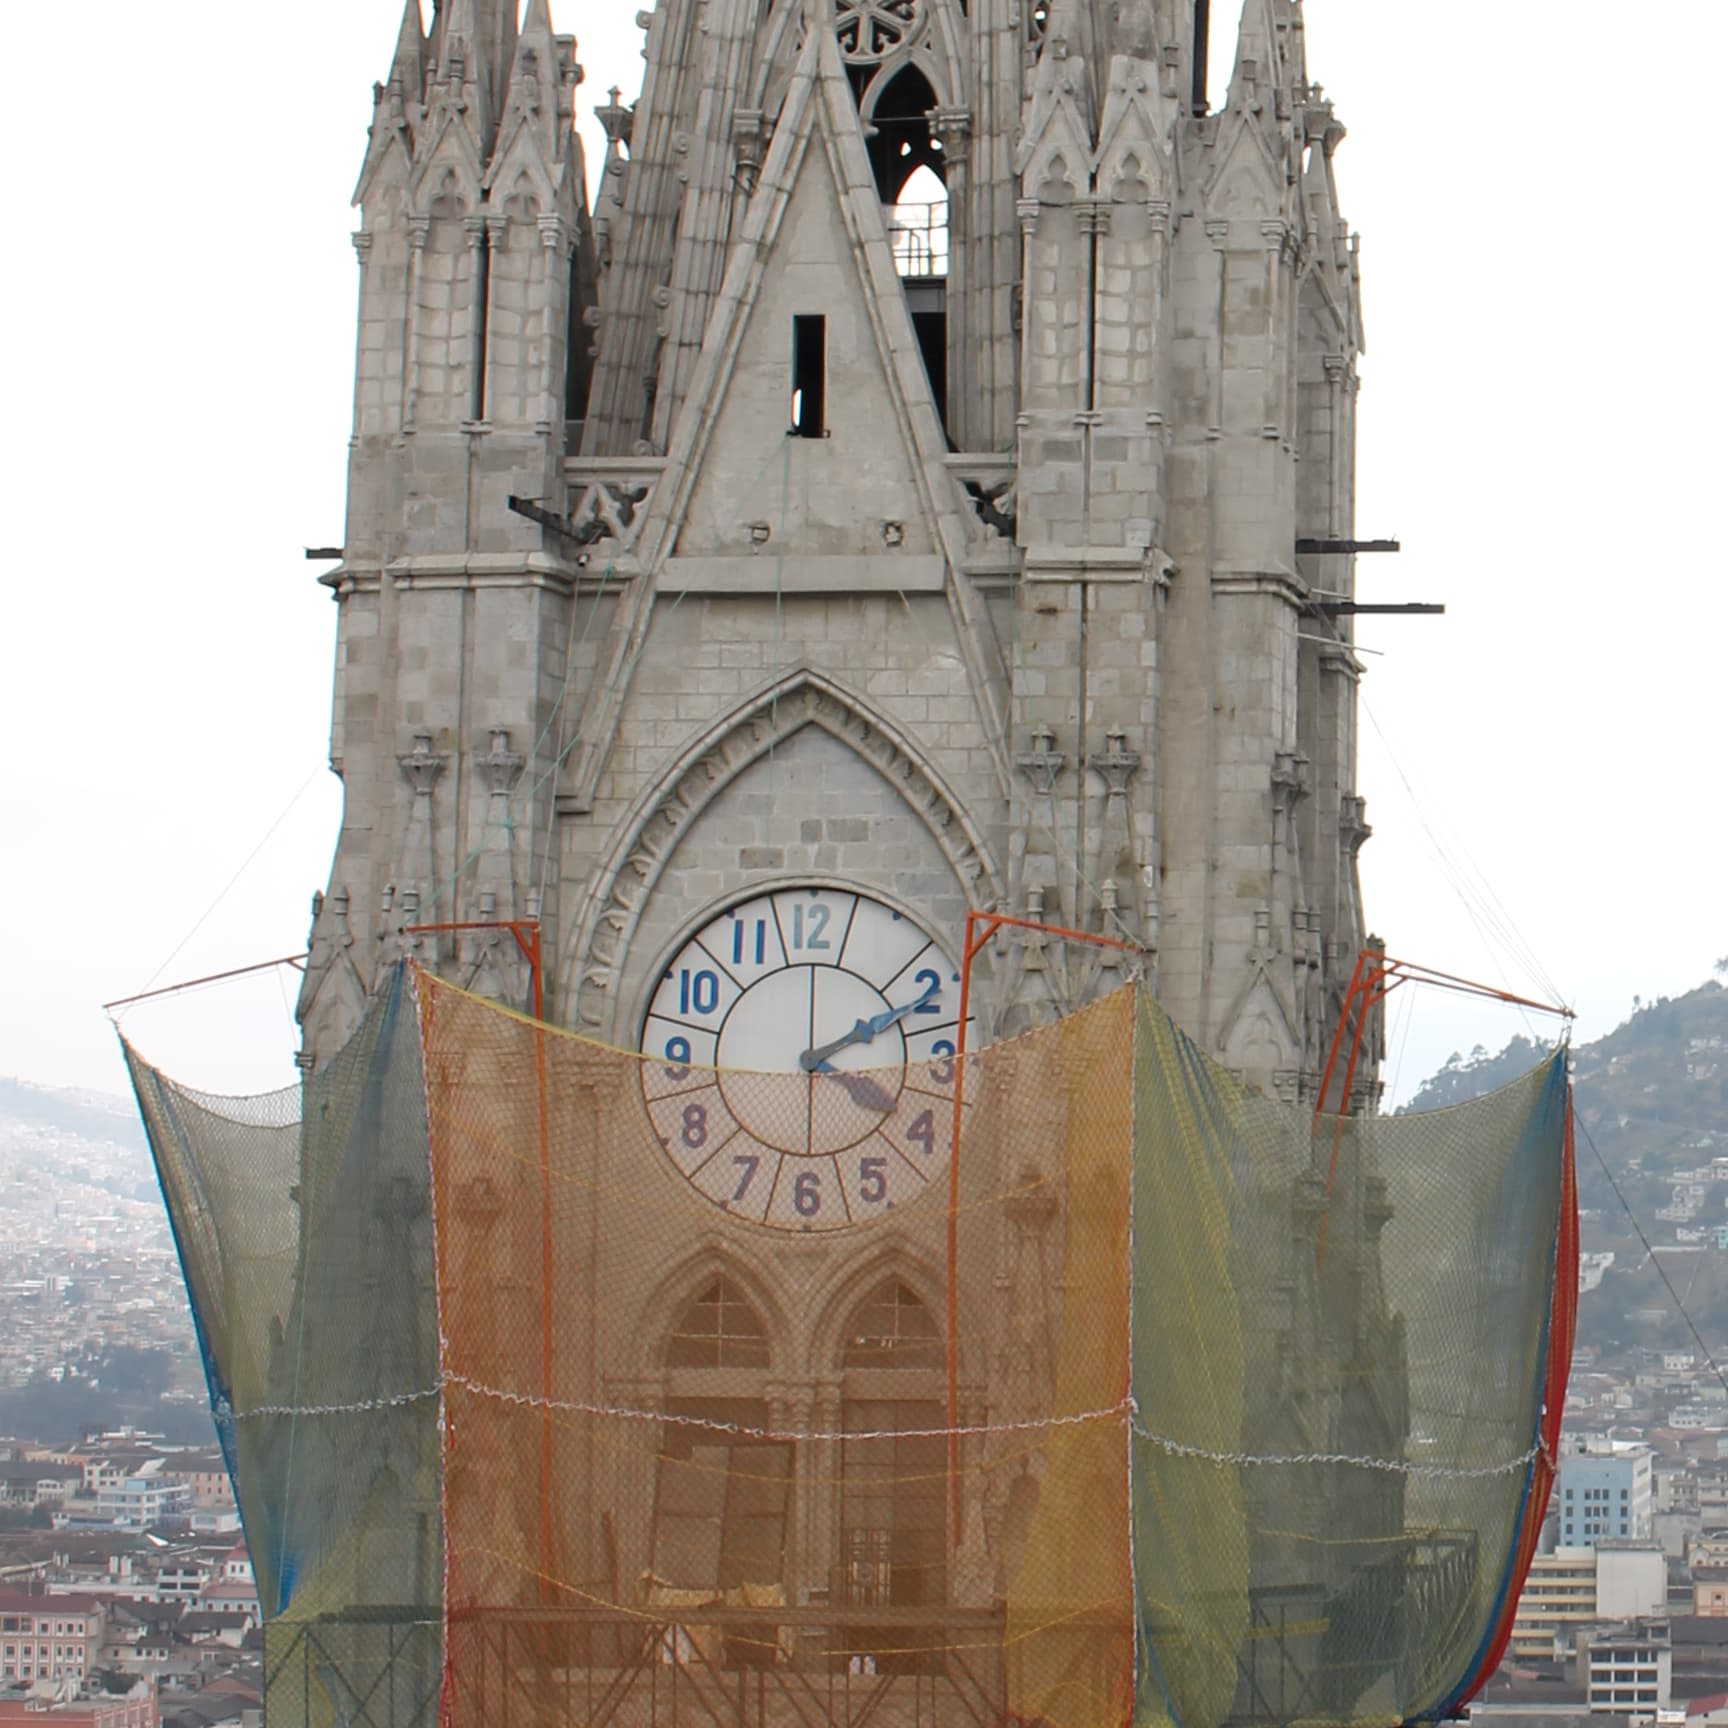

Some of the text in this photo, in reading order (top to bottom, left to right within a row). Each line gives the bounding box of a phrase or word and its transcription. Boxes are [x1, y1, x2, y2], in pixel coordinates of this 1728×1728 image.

[733, 919, 765, 964] 11
[793, 904, 831, 950] 12
[680, 969, 719, 1014] 10
[913, 968, 941, 1014] 2
[665, 1036, 690, 1081] 9
[929, 1040, 956, 1083] 3
[681, 1104, 708, 1148] 8
[906, 1109, 935, 1153] 4
[733, 1156, 759, 1200] 7
[795, 1172, 820, 1216] 6
[859, 1158, 887, 1202] 5
